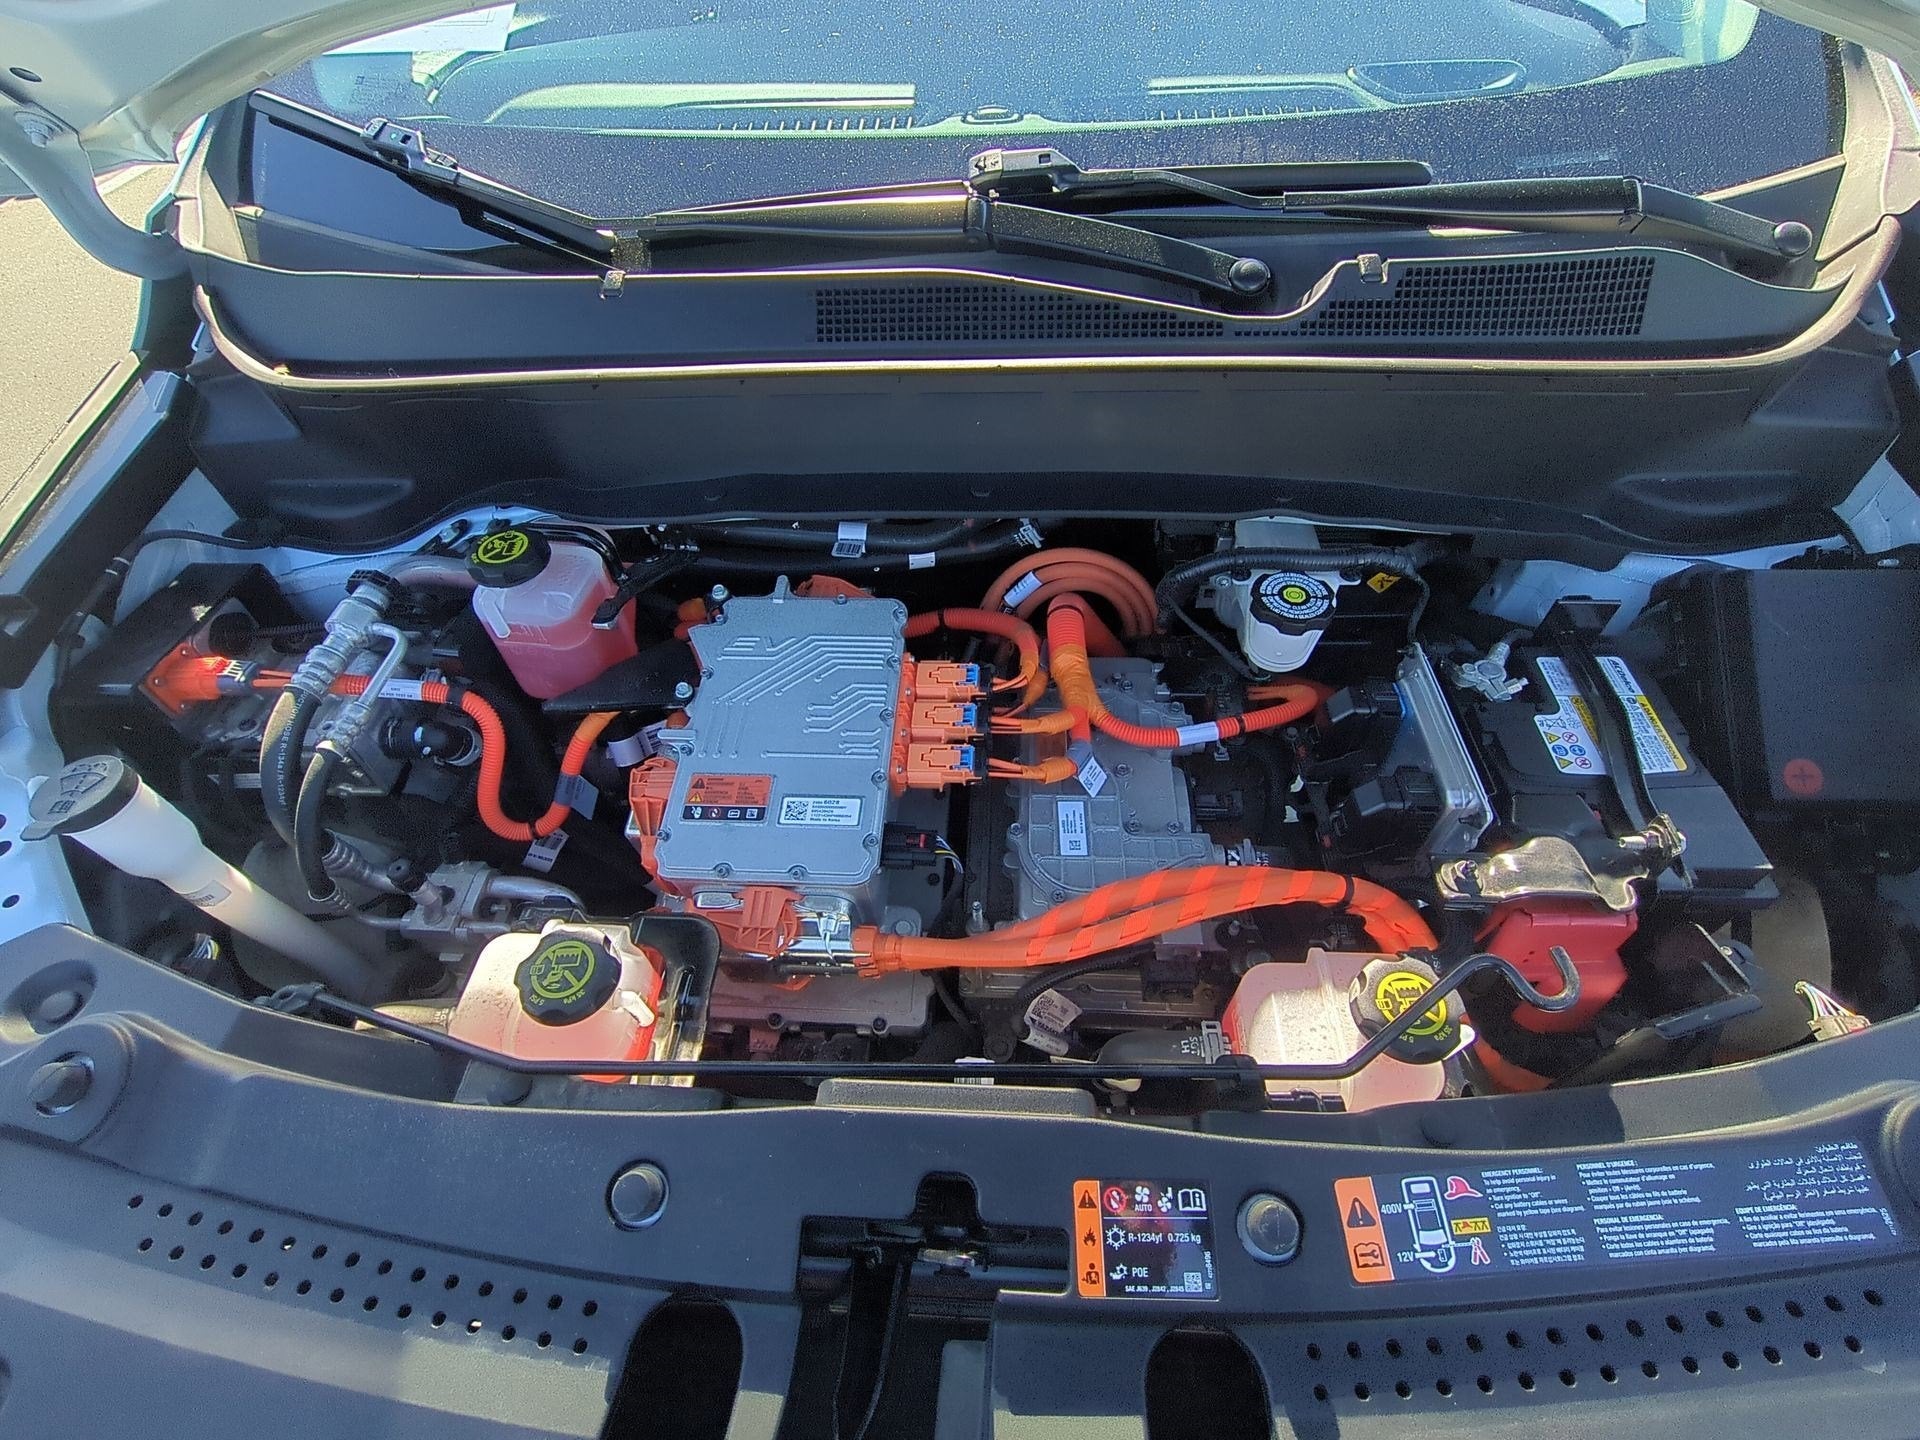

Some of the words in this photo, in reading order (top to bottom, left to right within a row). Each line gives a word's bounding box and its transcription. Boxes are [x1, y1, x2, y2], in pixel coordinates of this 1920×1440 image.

[281, 719, 294, 741] HOSE
[1135, 1204, 1152, 1212] AUTO
[1381, 1203, 1402, 1214] 400V
[1128, 1233, 1163, 1245] R-1234yf
[1167, 1233, 1190, 1243] 0.725
[1191, 1233, 1201, 1244] kg
[1397, 1251, 1414, 1262] 12V
[1132, 1267, 1148, 1277] POE
